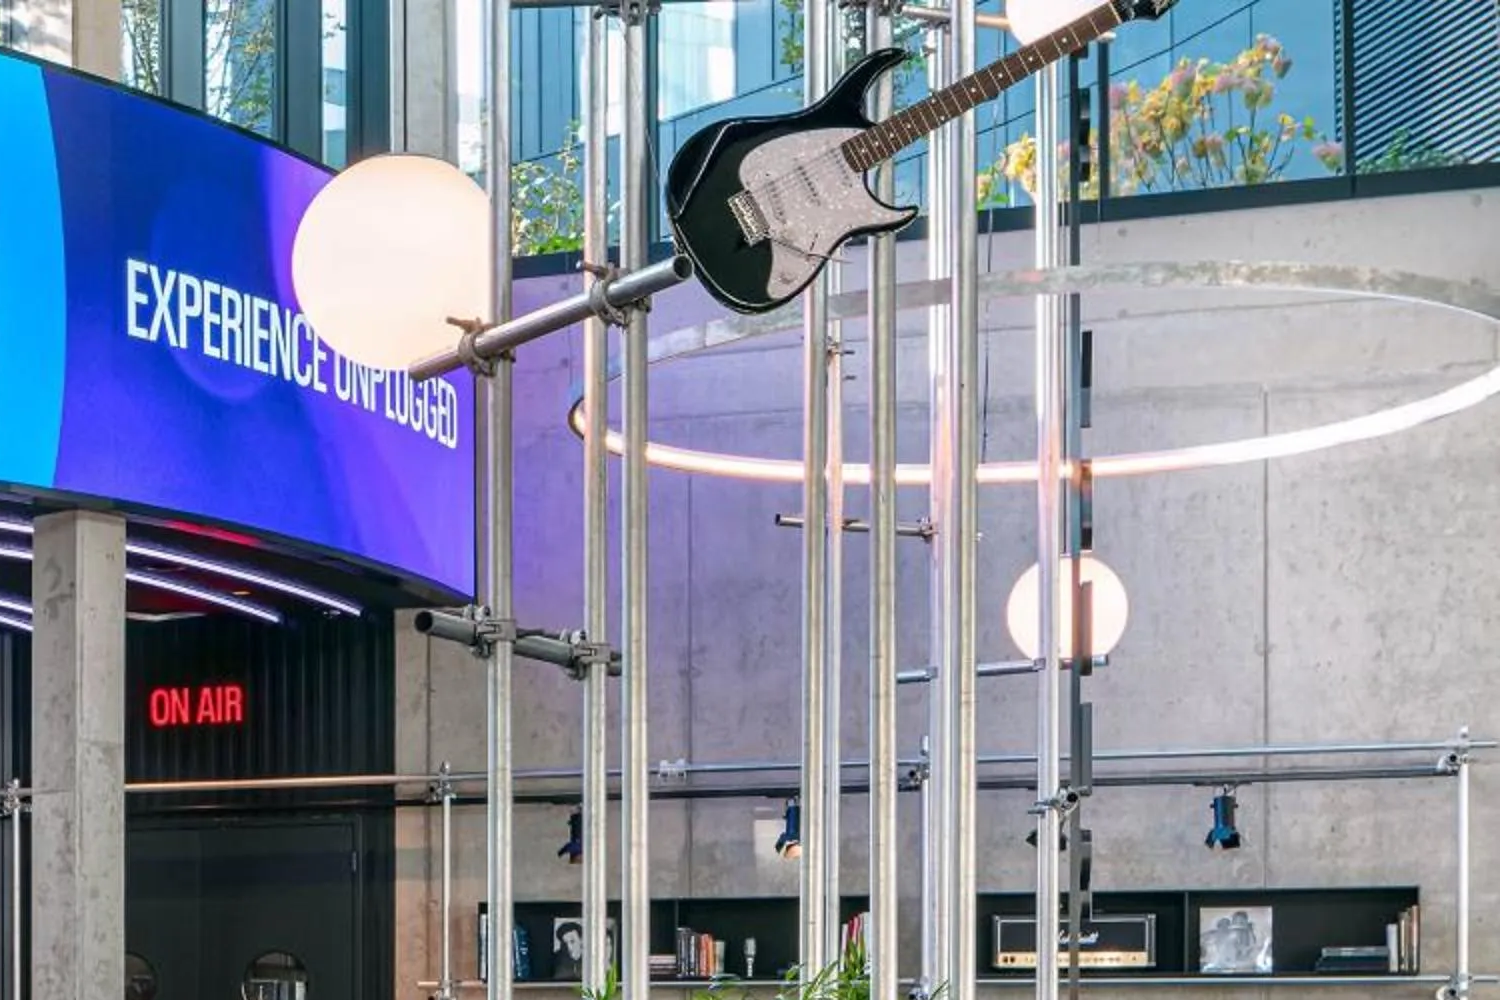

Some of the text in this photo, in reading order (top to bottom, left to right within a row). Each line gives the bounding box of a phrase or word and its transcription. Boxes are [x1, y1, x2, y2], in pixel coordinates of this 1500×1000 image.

[126, 257, 458, 450] EXPERIENCE UNPLUGGED
[149, 685, 243, 727] ON AIR
